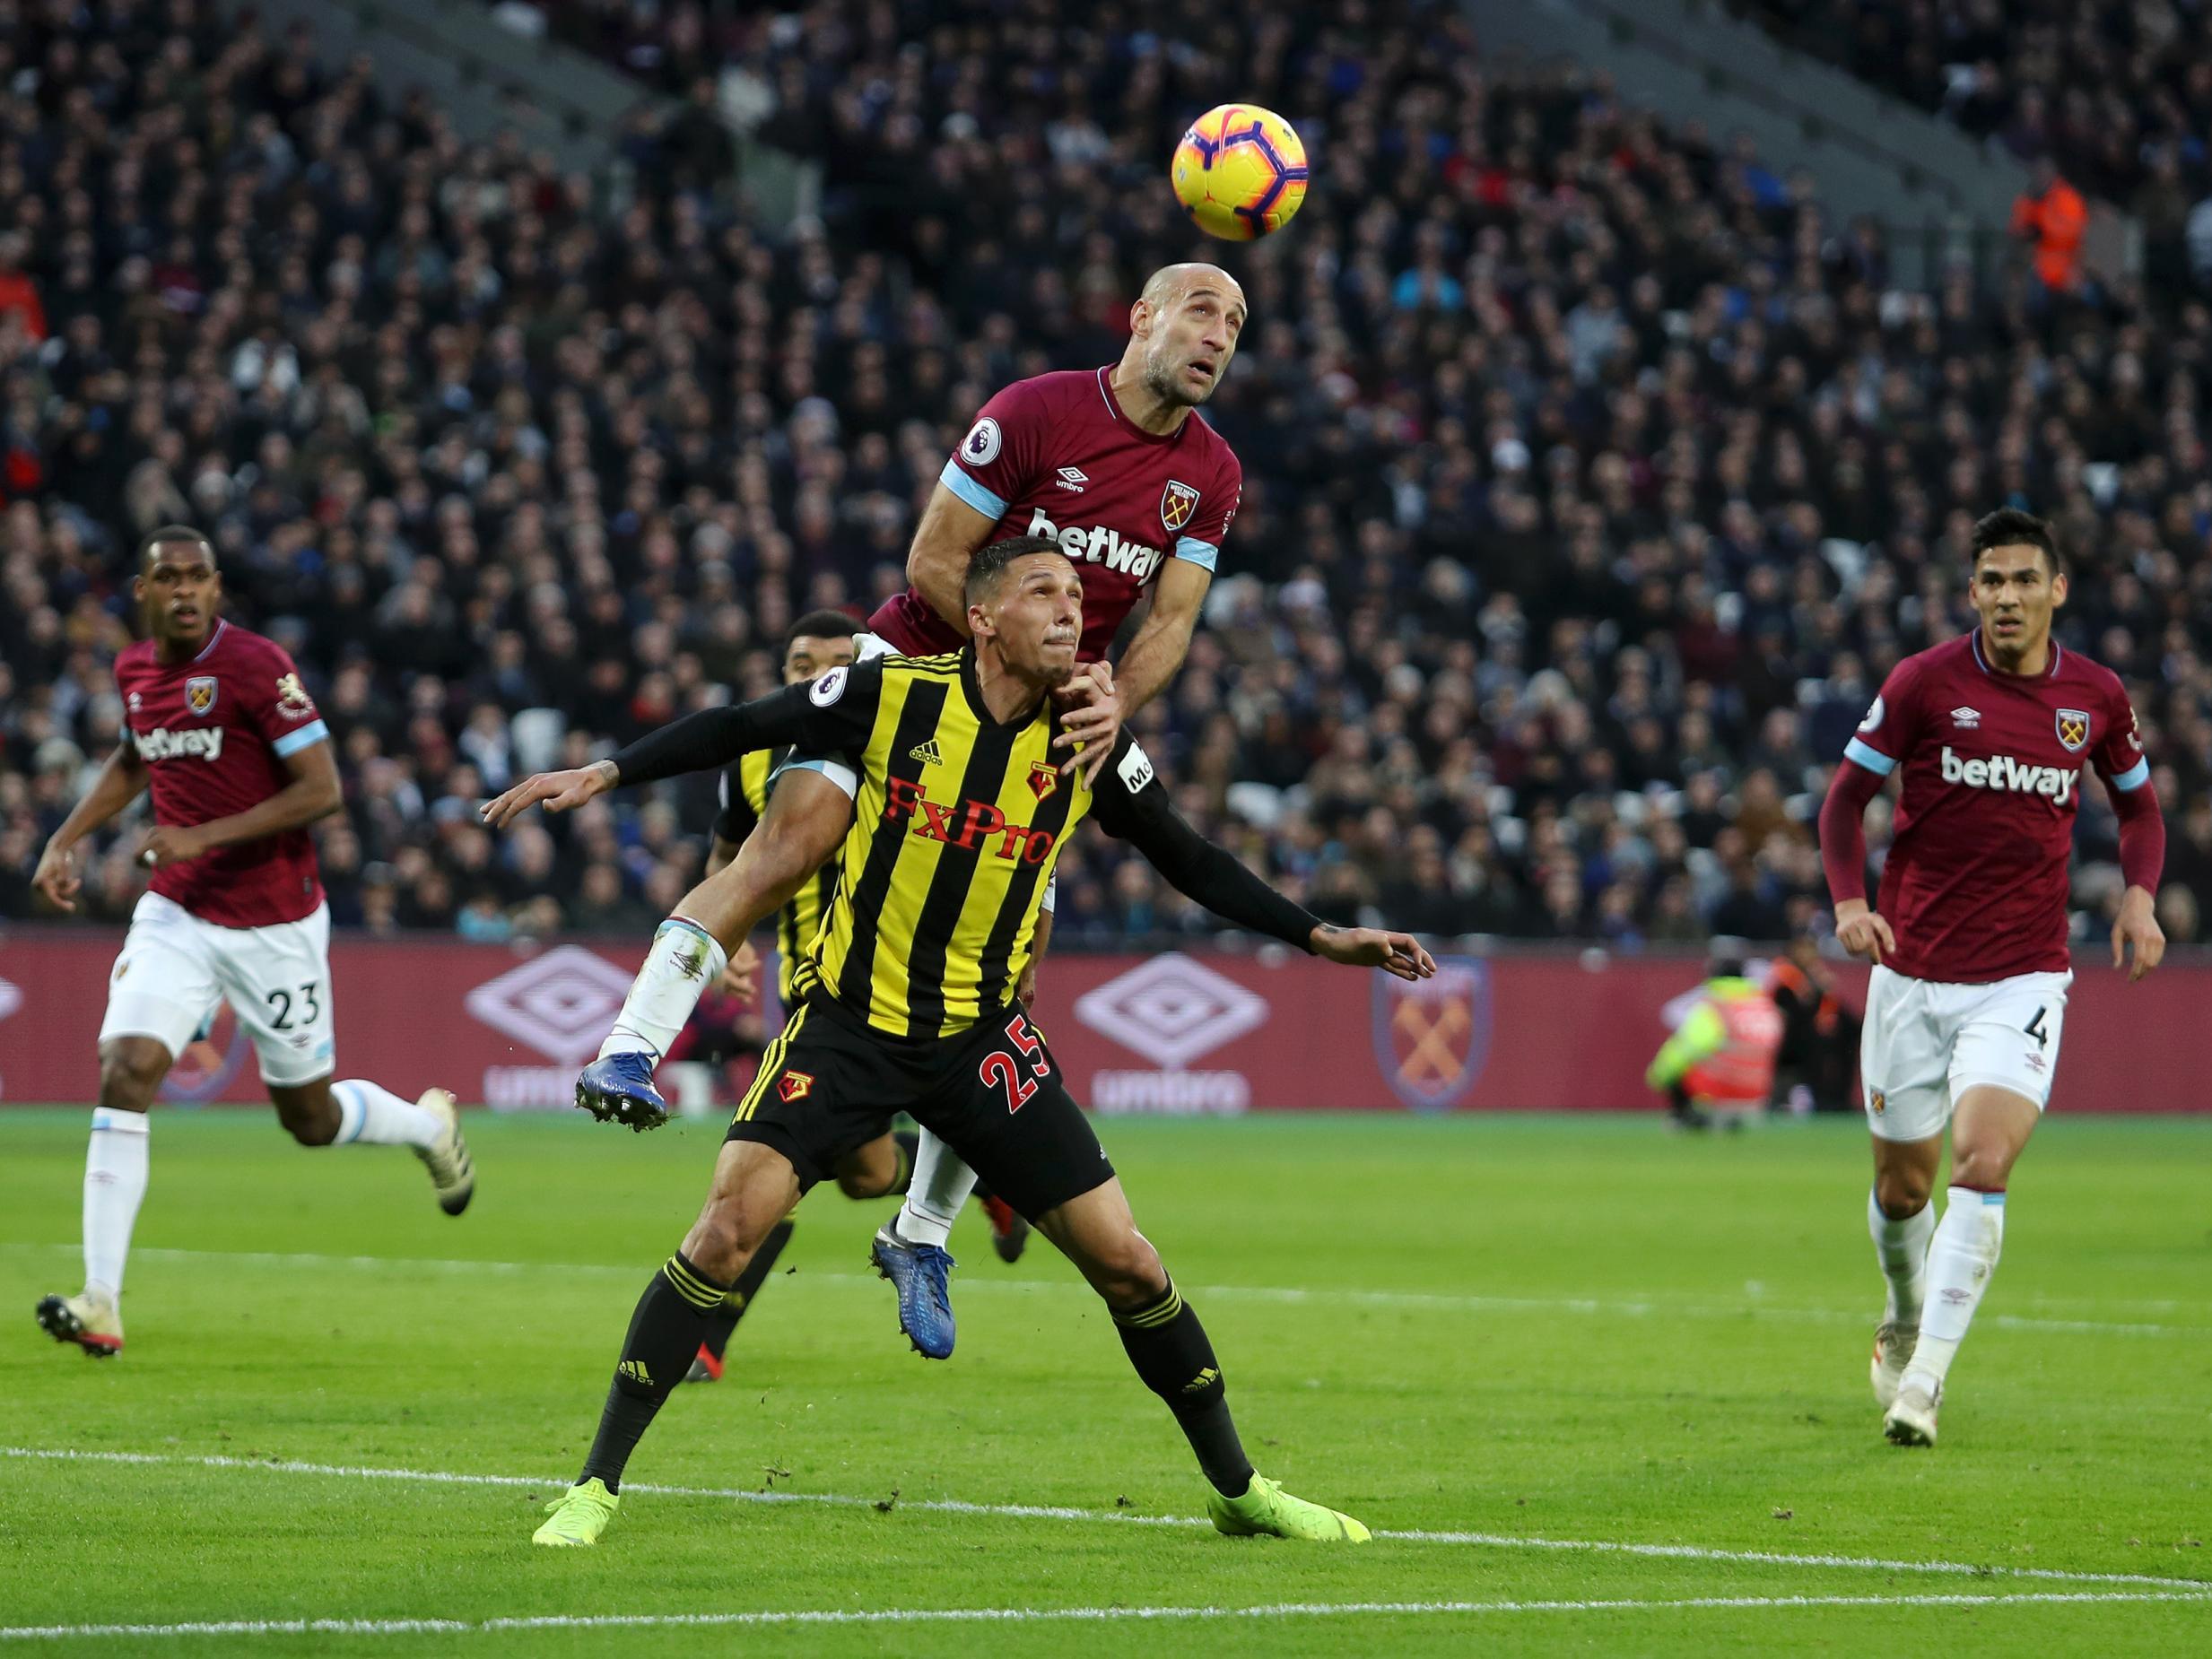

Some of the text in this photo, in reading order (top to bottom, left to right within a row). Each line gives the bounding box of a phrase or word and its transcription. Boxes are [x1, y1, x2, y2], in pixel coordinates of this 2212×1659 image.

[1056, 480, 1084, 493] umbro
[1027, 508, 1164, 586] betway
[910, 750, 943, 767] adidas
[1941, 746, 2078, 805] betway
[884, 776, 1054, 864] FxPro
[267, 981, 319, 1029] 23
[2024, 1004, 2048, 1050] 4
[979, 1014, 1050, 1115] 25
